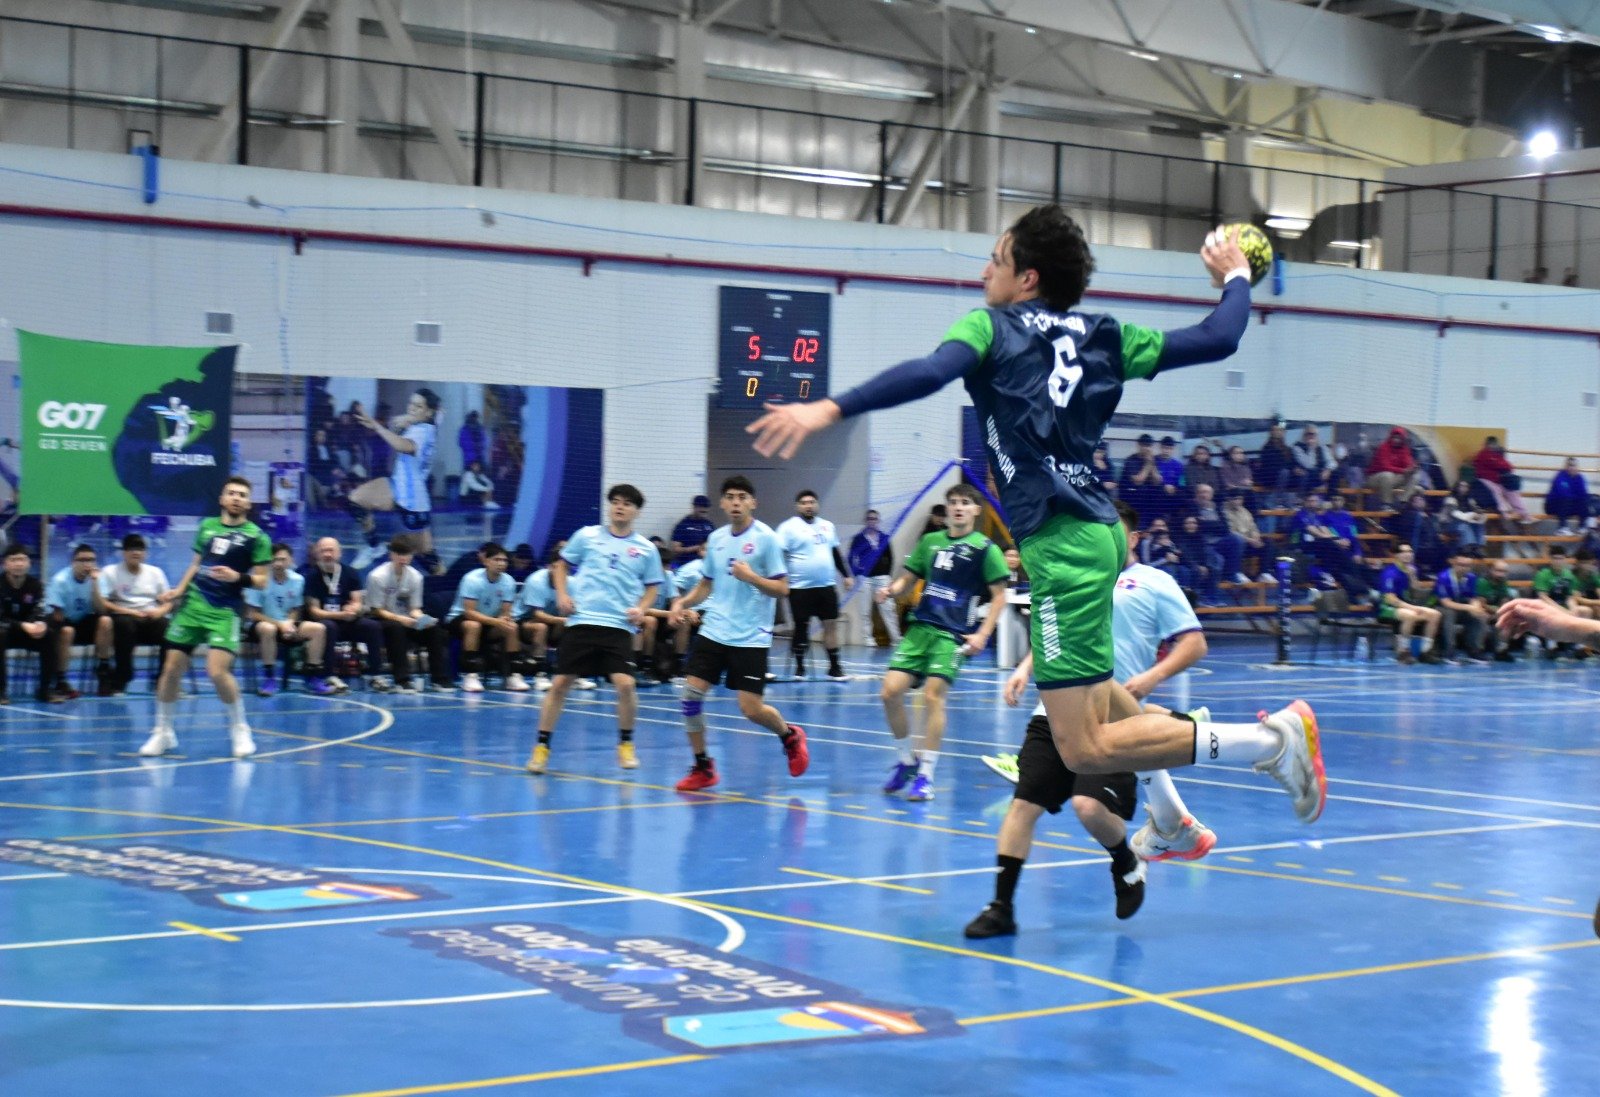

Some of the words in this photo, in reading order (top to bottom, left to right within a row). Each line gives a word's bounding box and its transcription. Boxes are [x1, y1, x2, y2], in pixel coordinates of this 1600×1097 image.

[747, 334, 761, 361] 5
[792, 337, 819, 363] 02
[1047, 334, 1084, 409] 6
[745, 377, 759, 397] 0
[799, 379, 811, 399] 0
[37, 400, 107, 430] GO7
[38, 438, 61, 450] GO
[62, 440, 107, 452] SEVEN
[150, 453, 217, 467] FECHUBA
[1209, 731, 1219, 760] GO7
[614, 938, 824, 998] Rivadavia
[676, 982, 751, 1003] de
